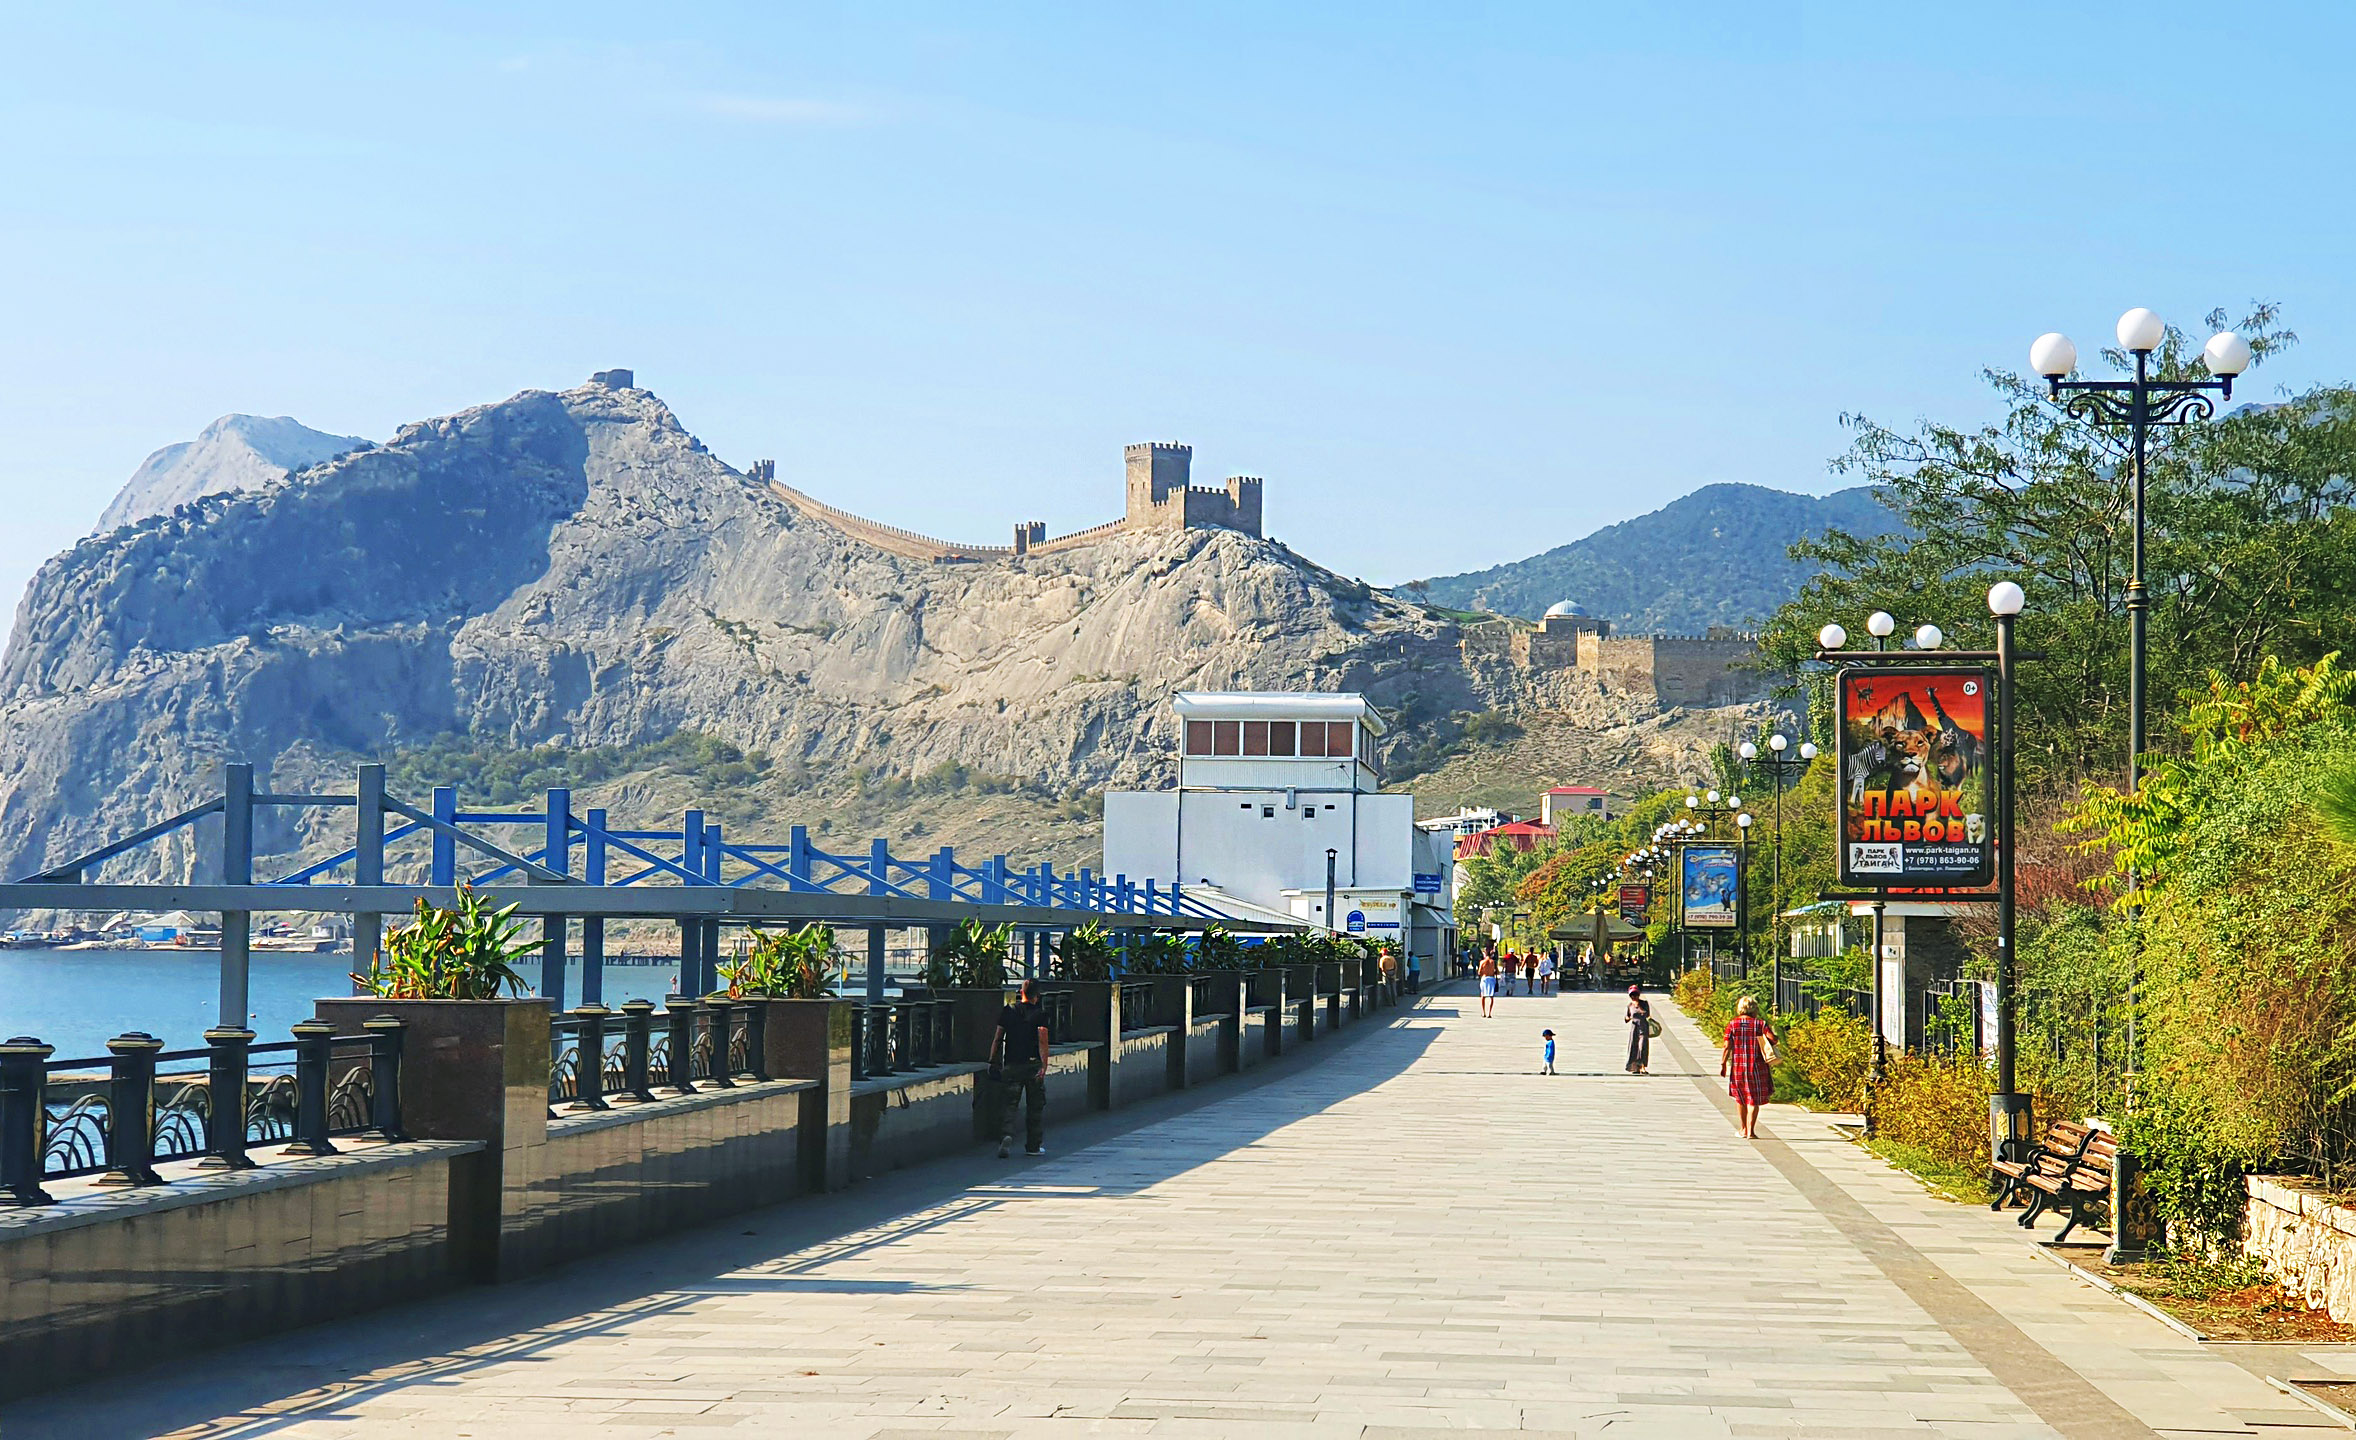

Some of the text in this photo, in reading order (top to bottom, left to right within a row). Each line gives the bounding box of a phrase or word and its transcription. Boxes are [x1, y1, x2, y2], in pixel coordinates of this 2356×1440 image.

[1965, 684, 1976, 692] 0+
[1864, 790, 1964, 817] ПАРК
[1861, 820, 1965, 842] ЛЬВОВ
[1917, 857, 1937, 865] (978)
